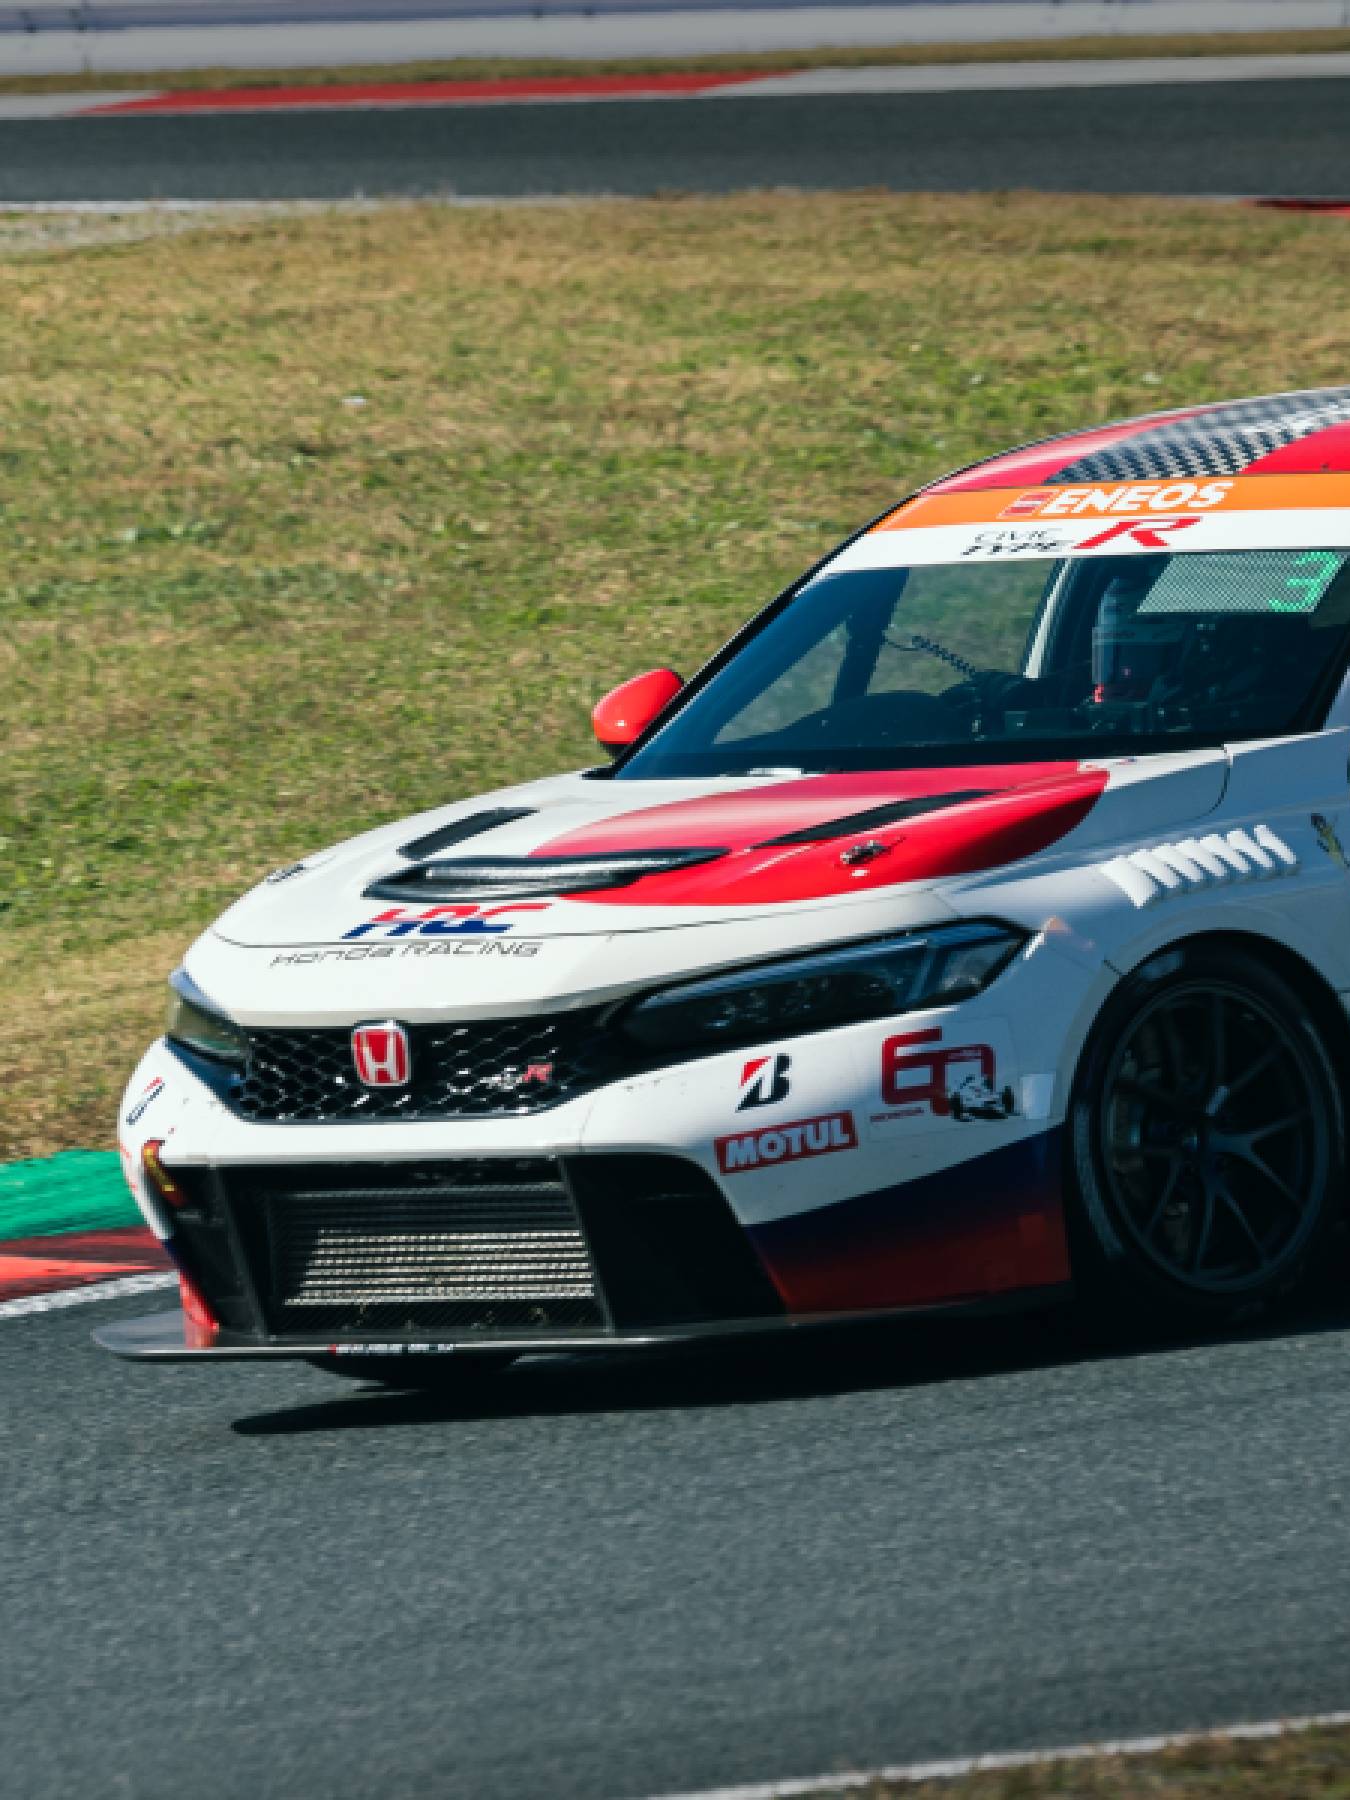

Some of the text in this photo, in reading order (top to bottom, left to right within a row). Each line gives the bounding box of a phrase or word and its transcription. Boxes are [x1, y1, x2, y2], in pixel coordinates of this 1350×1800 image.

[1042, 482, 1232, 514] ENEOS
[974, 528, 1064, 543] CIVIC
[1074, 517, 1202, 549] R
[1268, 551, 1340, 613] 3
[341, 903, 553, 939] HRC
[726, 1118, 850, 1167] MOTUL
